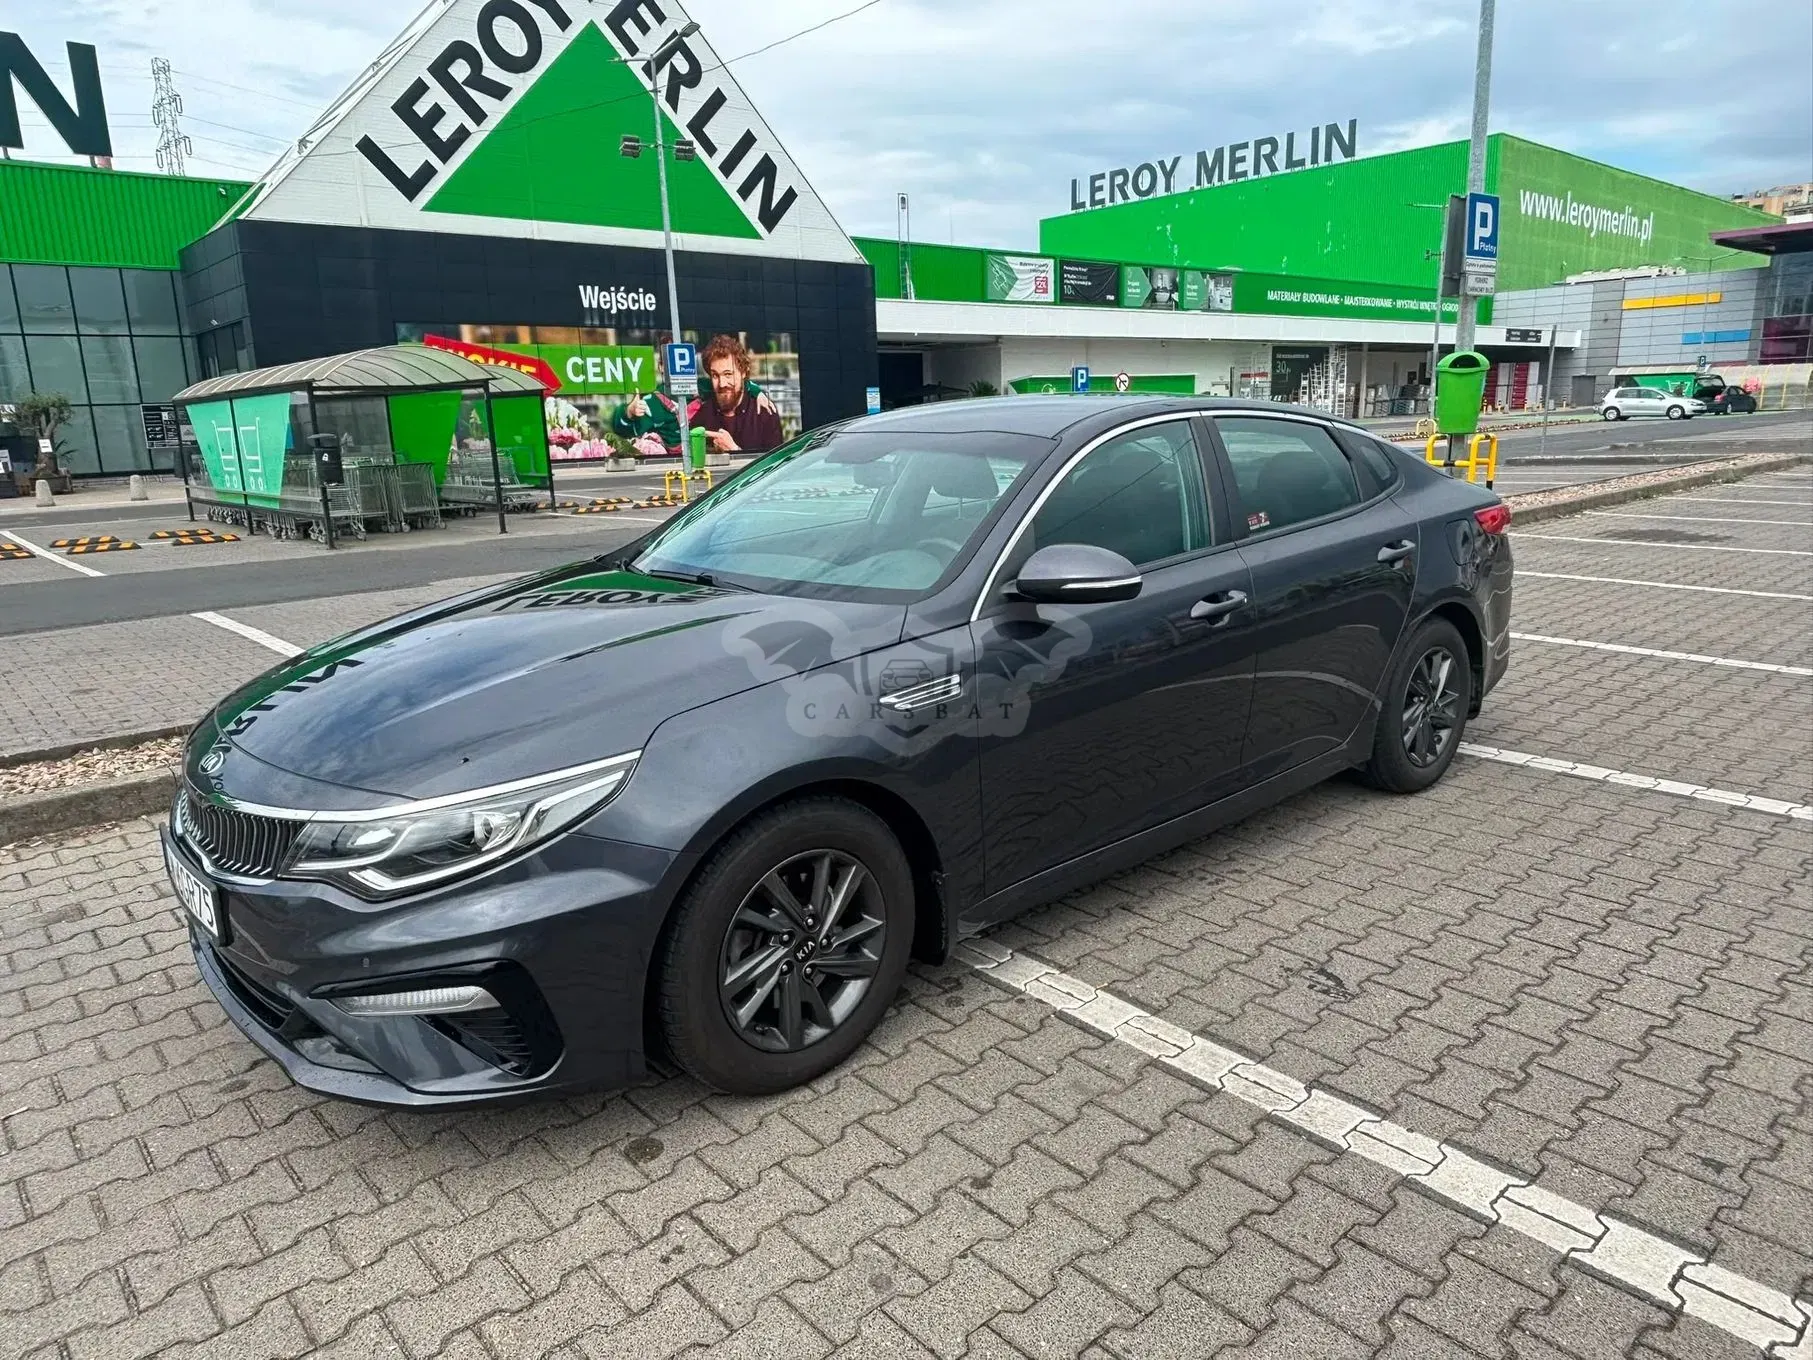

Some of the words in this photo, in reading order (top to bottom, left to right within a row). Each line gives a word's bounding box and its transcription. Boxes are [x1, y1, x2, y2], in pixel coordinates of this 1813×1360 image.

[604, 0, 798, 233] ERLIN
[1071, 156, 1182, 210] LEROY
[1196, 118, 1357, 187] MERLIN
[1474, 201, 1493, 251] P
[1519, 189, 1654, 247] www.leroymerlin.pl
[578, 285, 656, 314] Wejście
[565, 356, 643, 383] CENY
[674, 348, 690, 373] P
[1077, 369, 1087, 389] P
[796, 940, 815, 960] KIA
